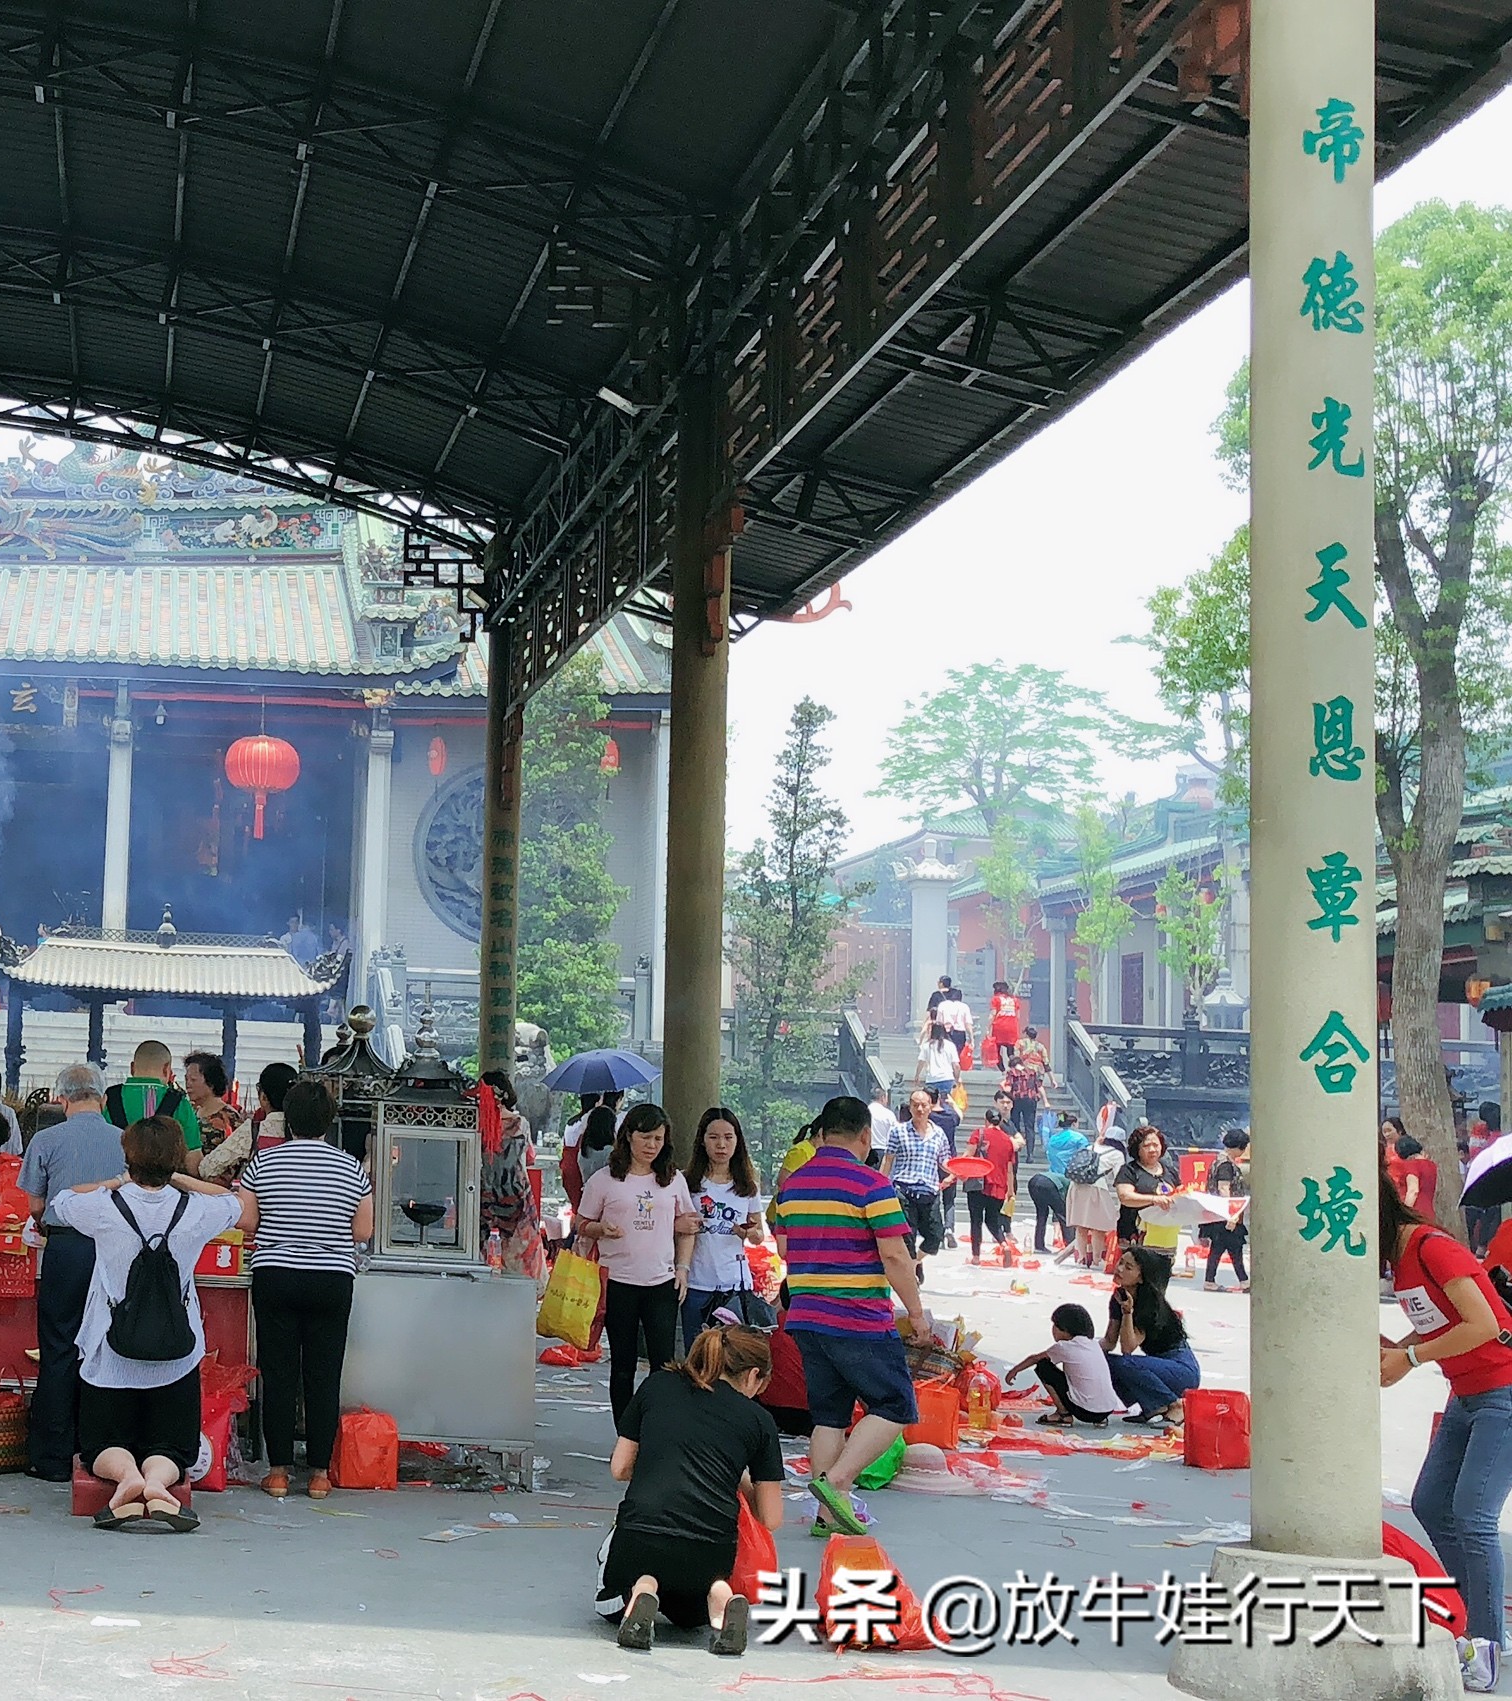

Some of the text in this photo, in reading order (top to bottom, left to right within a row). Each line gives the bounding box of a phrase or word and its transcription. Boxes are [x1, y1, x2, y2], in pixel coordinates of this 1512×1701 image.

[1295, 97, 1370, 1257] 帝德光天恩覃合境
